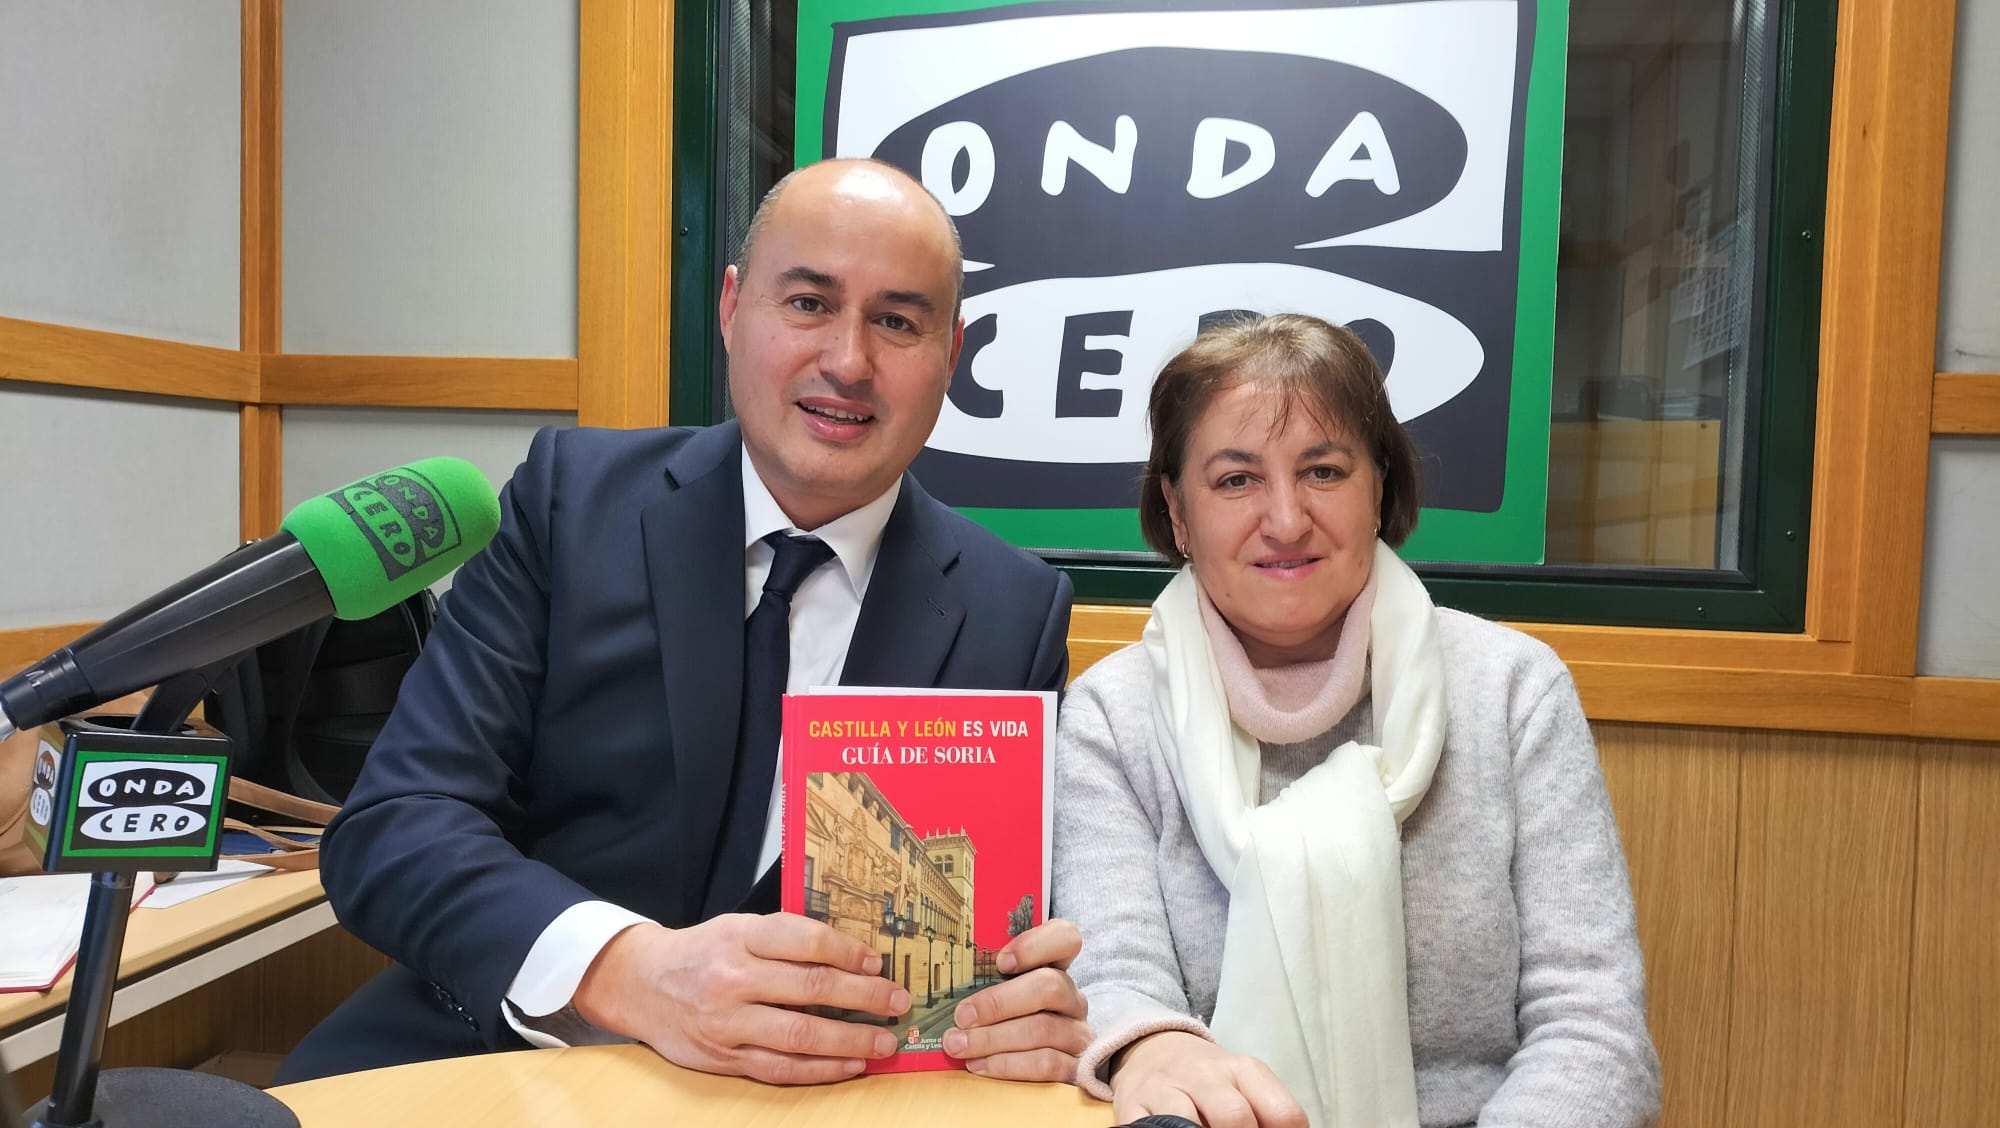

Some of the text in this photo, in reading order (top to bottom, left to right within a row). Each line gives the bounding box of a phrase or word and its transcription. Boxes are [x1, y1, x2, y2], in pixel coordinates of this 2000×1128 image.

[921, 111, 1400, 216] ONDA
[946, 309, 1396, 418] CE
[353, 490, 411, 556] CERO
[383, 476, 438, 540] ONDA
[809, 717, 1029, 738] CASTILLA Y LEÓN ES VIDA
[841, 742, 997, 765] GUÍA DE SORIA
[98, 778, 195, 797] ONDA
[99, 813, 190, 833] CERO
